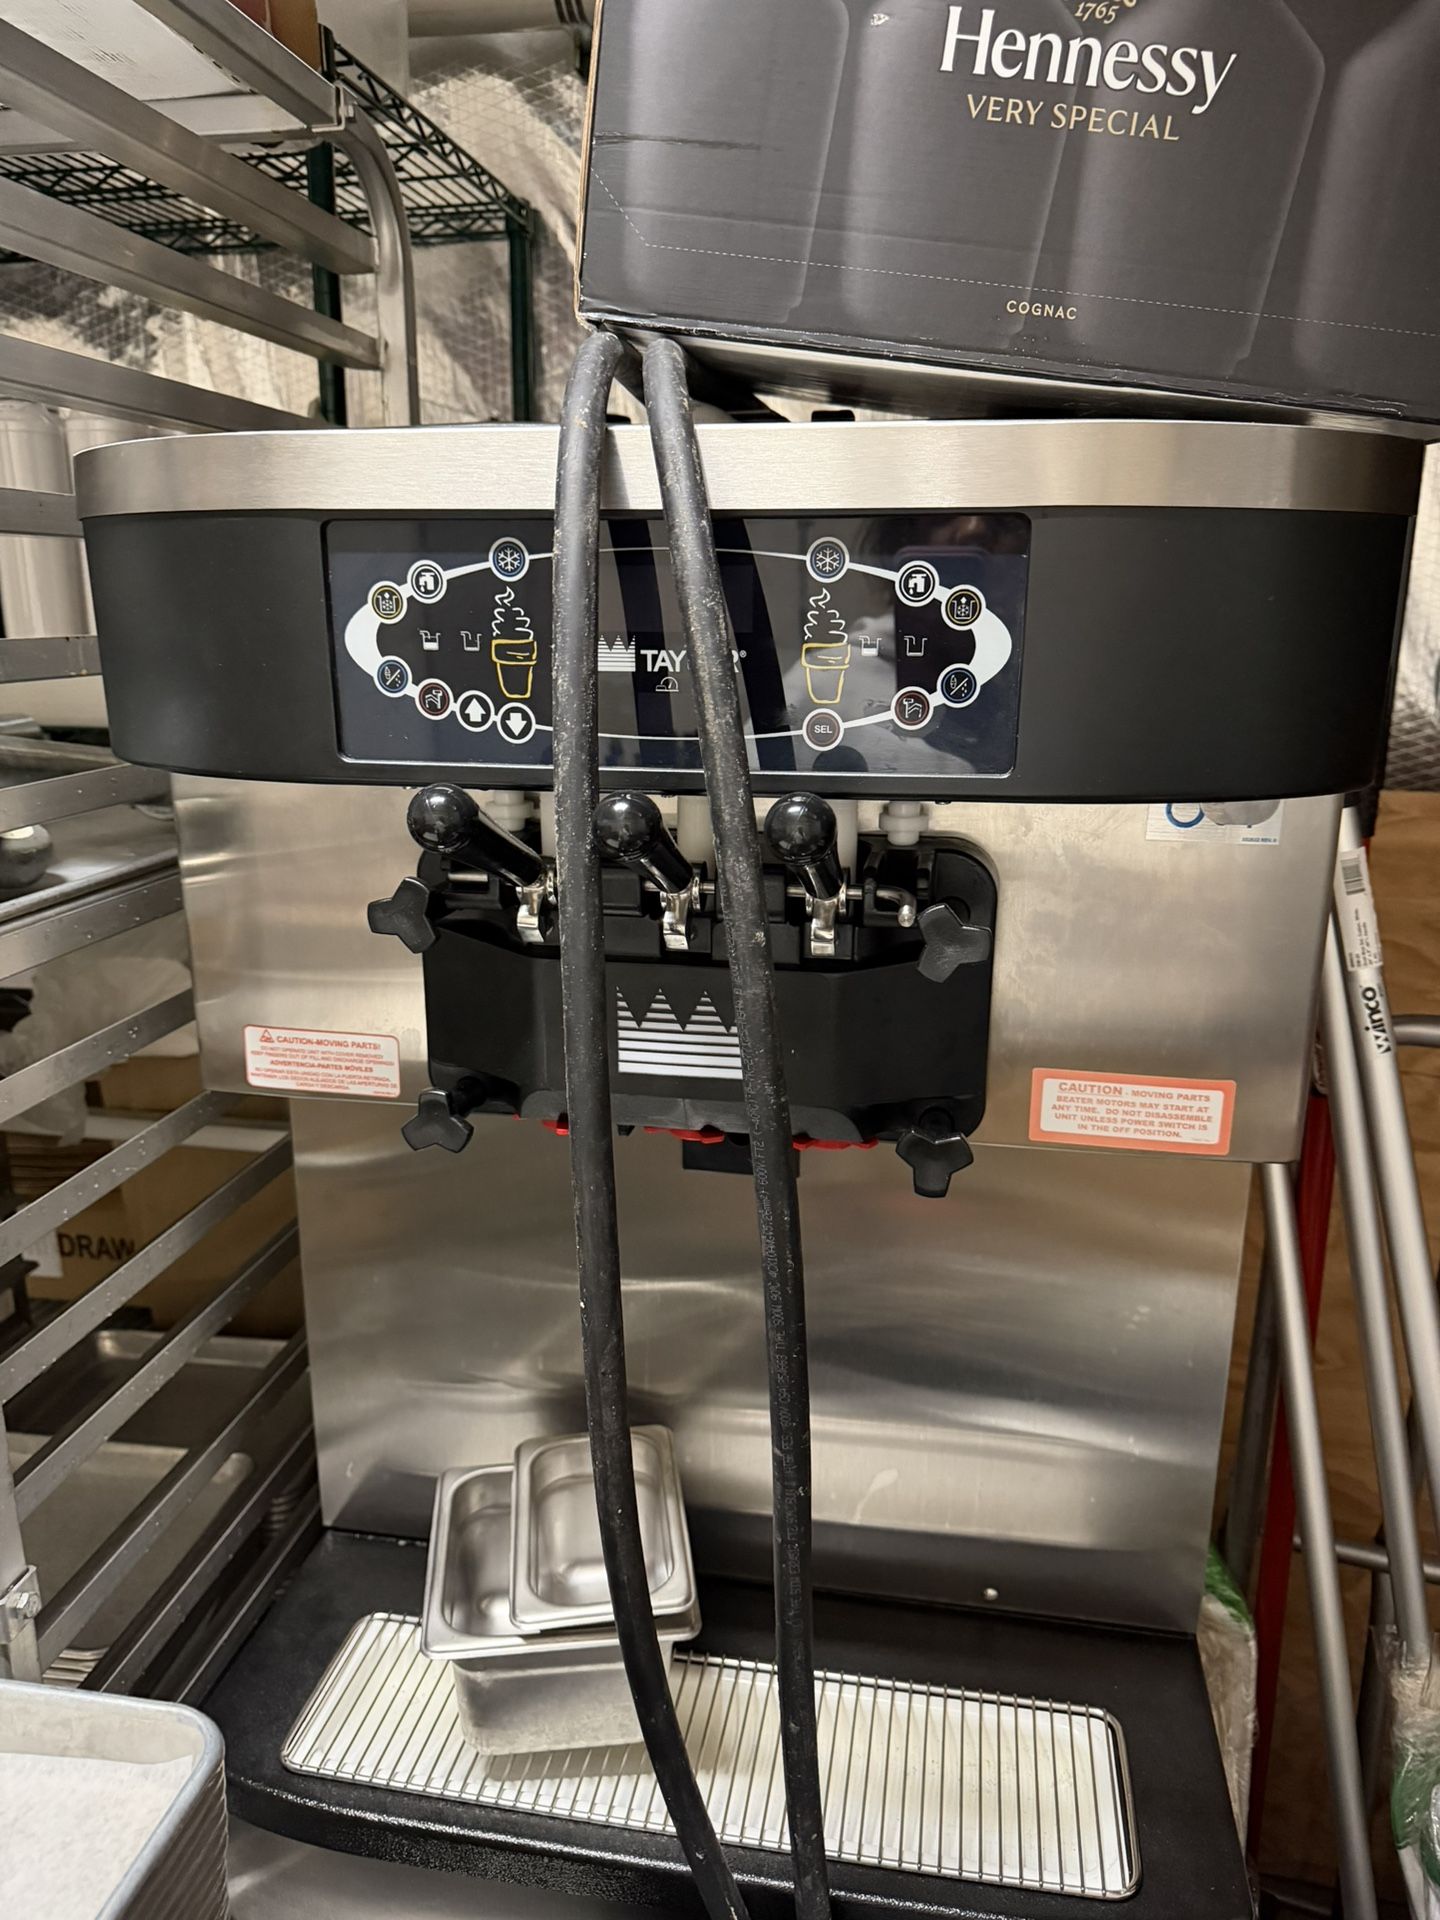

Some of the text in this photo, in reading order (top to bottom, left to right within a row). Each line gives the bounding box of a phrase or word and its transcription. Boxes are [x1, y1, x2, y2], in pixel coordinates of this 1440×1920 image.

[1074, 2, 1119, 24] 1765
[940, 5, 1237, 114] Hennessy
[967, 94, 1180, 141] VERY SPECIAL
[1006, 300, 1078, 320] COGNAC
[813, 724, 833, 735] SEL
[276, 1035, 349, 1047] CAUTION-MOVING
[1058, 1081, 1122, 1095] CAUTION
[1131, 1090, 1173, 1099] MOVING
[1176, 1093, 1210, 1101] PARTS
[1056, 1095, 1093, 1104] BEATER
[1096, 1098, 1136, 1107] MOTORS
[1139, 1100, 1159, 1108] MAY
[1162, 1102, 1193, 1110] START
[1051, 1103, 1212, 1121] ANY TIME. DO NOT DISASSEMBLE
[1054, 1112, 1076, 1120] UNIT
[1080, 1114, 1117, 1123] UNLESS
[1120, 1116, 1154, 1125] POWER
[1158, 1119, 1195, 1128] SWITCH
[1091, 1124, 1109, 1132] THE
[1112, 1125, 1131, 1133] OFF
[1133, 1127, 1182, 1136] POSITION.
[752, 1140, 765, 1158] FT2
